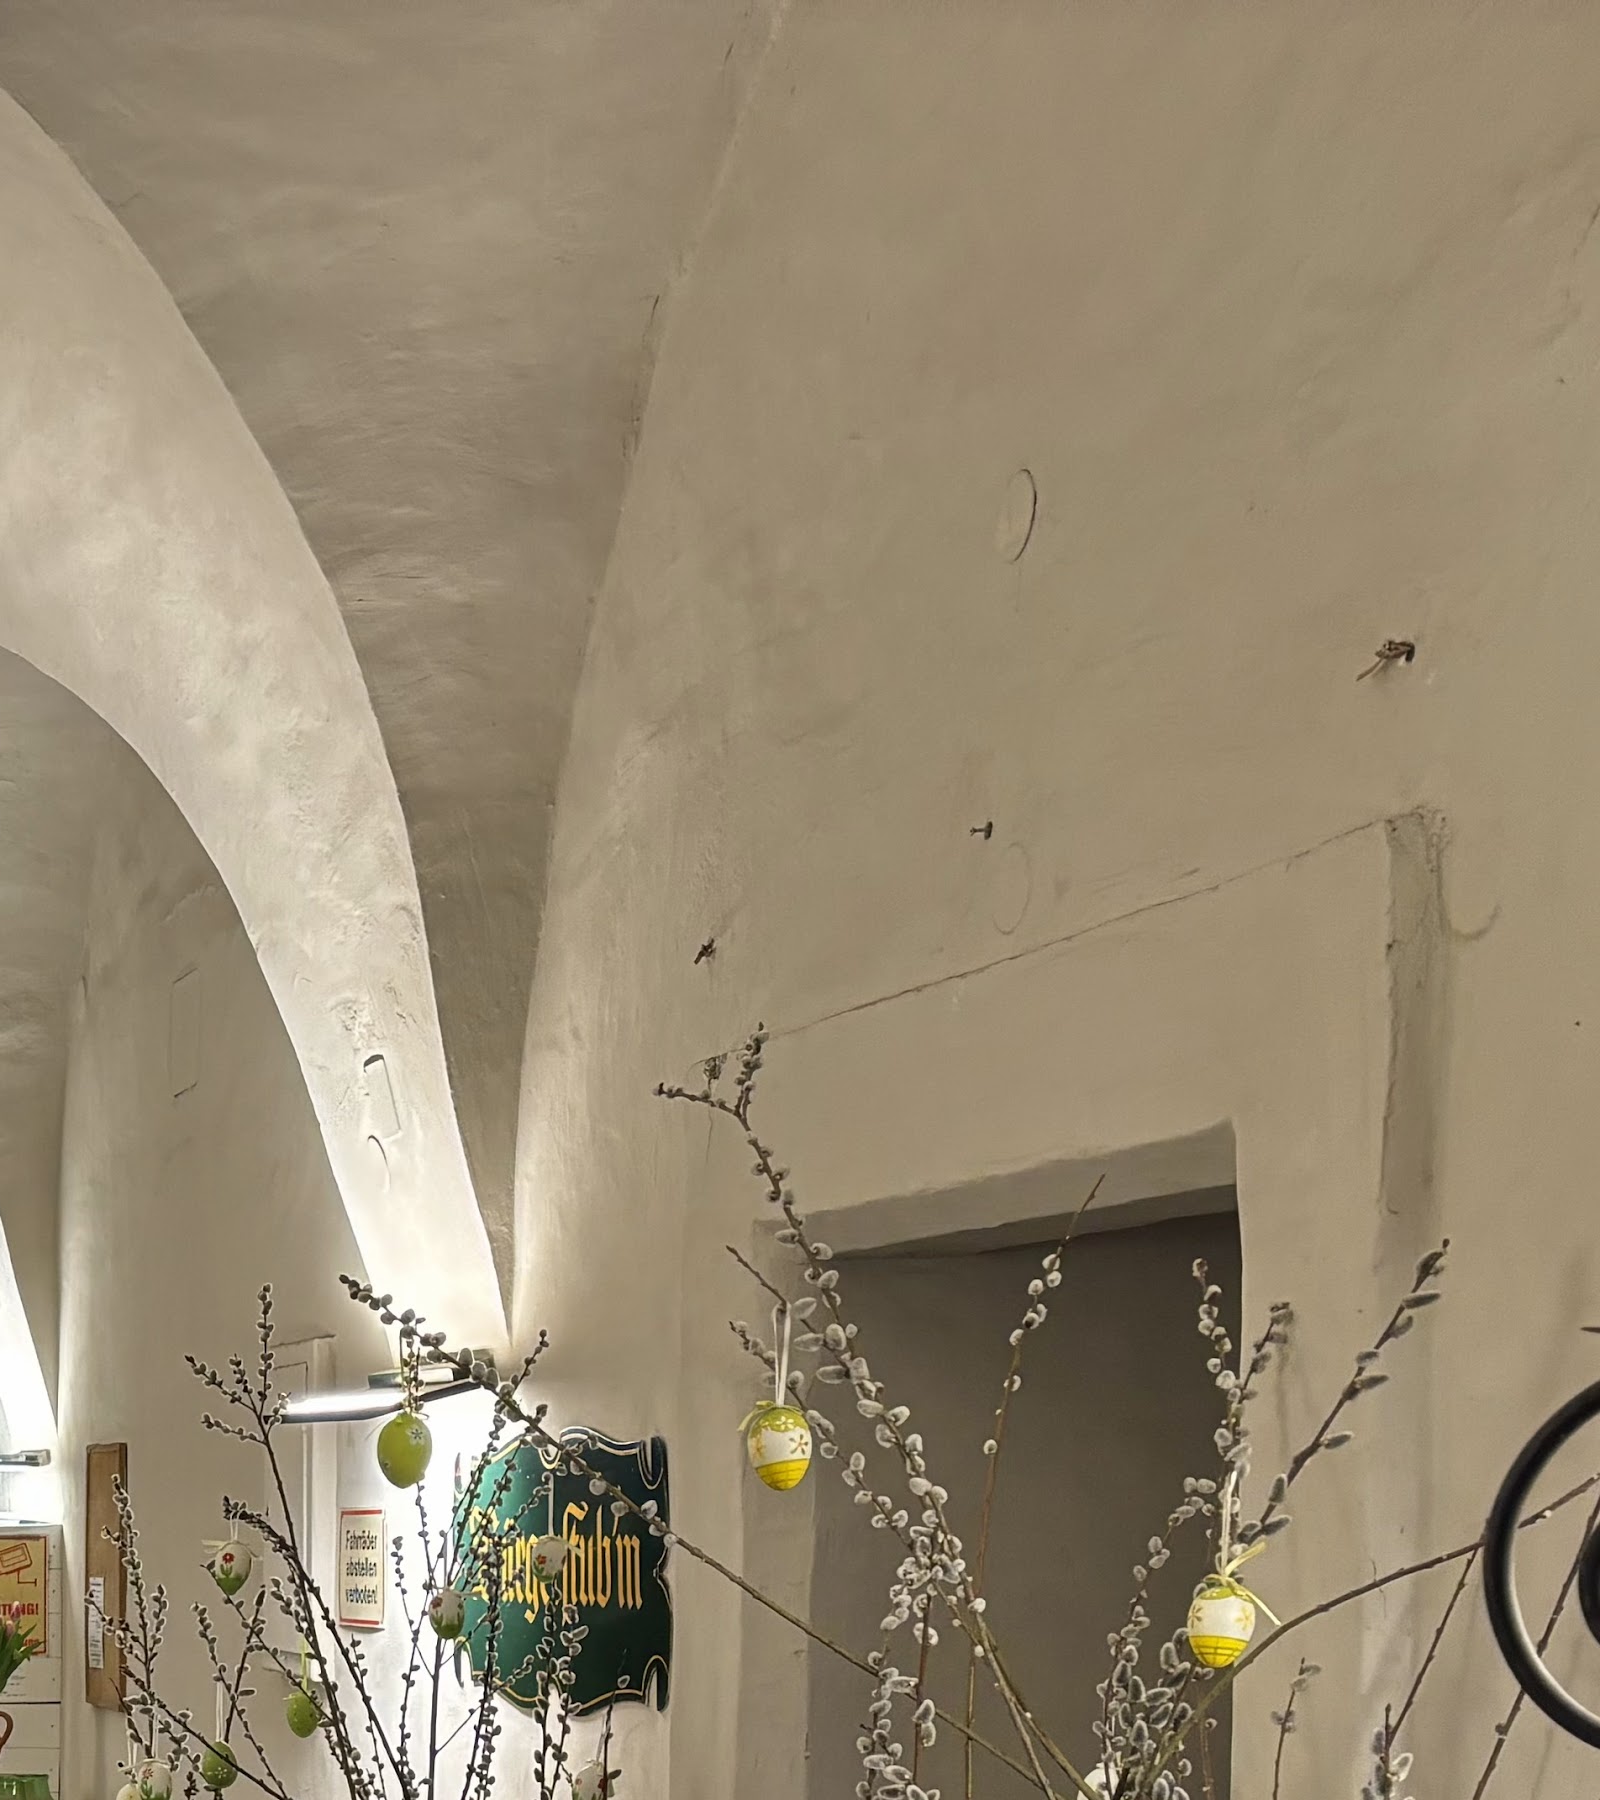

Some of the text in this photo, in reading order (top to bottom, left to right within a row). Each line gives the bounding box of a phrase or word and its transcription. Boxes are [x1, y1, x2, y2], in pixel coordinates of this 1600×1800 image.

[345, 1529, 378, 1550] Fahrräder
[345, 1557, 378, 1577] abstellen
[345, 1583, 378, 1604] verboten!
